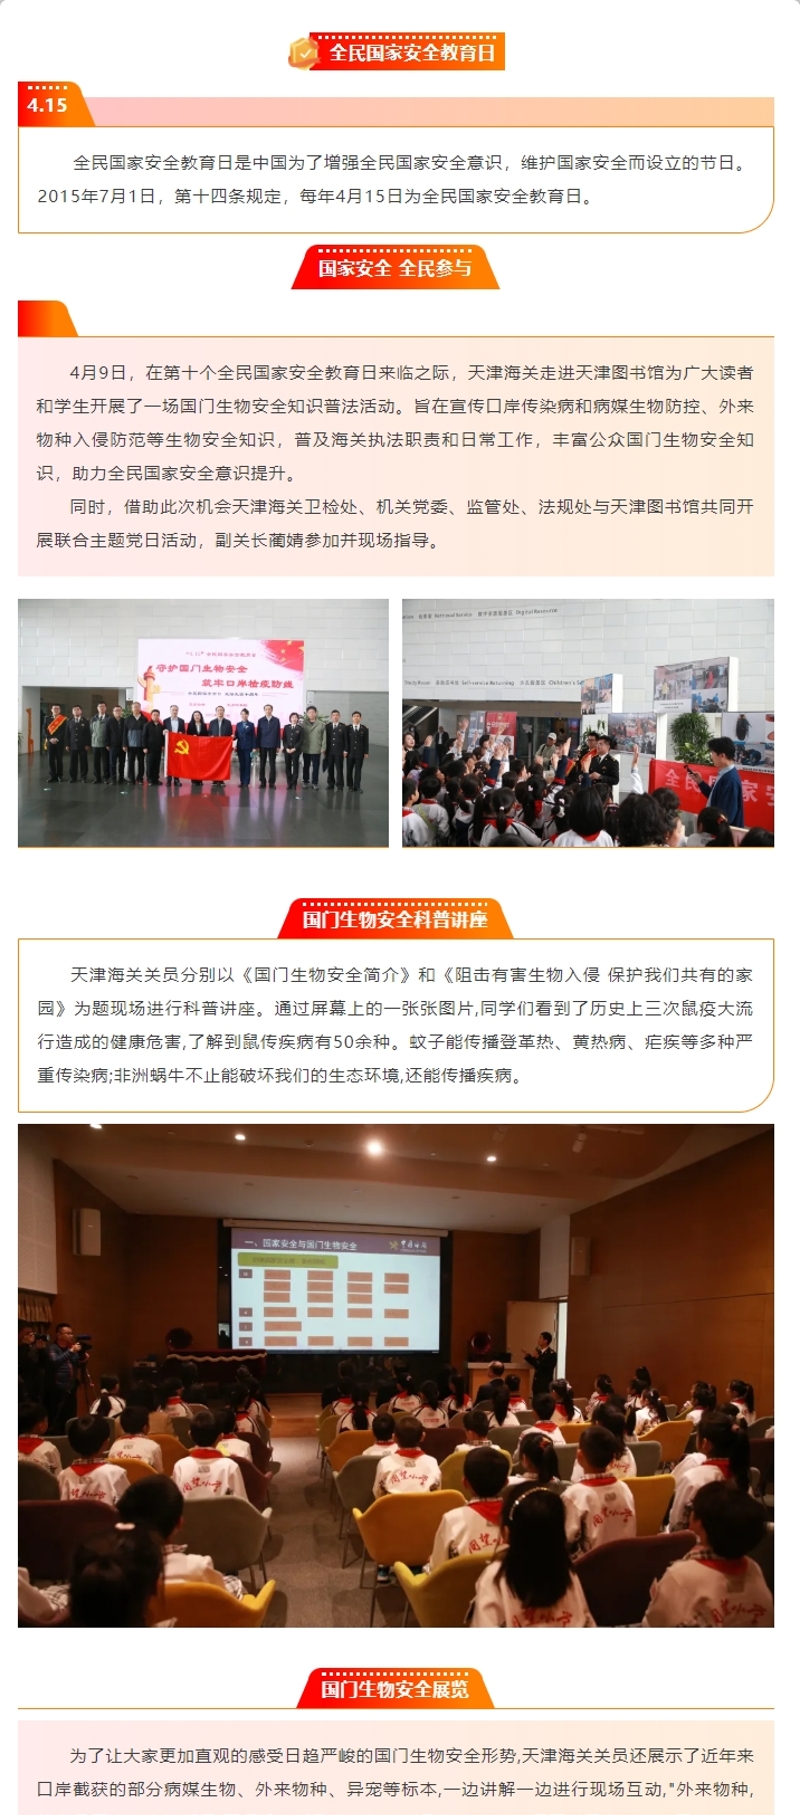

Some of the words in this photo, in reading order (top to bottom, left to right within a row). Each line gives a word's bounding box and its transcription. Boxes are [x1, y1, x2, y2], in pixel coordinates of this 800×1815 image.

[330, 43, 495, 63] 全民国家安全教育日
[27, 97, 67, 113] 4.15
[73, 154, 742, 172] 全民国家安全教育日是中国为了增强全民国家安全意识，维护国家安全而设立的节日。
[37, 188, 590, 206] 2015年7月1日，第十四条规定，每年4月15日为全民国家安全教育日。
[319, 258, 393, 279] 国家安全
[399, 258, 472, 279] 全民参与
[69, 364, 754, 382] 4月9日，在第十个全民国家安全教育日来临之际，天津海关走进天津图书馆为广大读者
[36, 397, 755, 416] 和学生开展了一场国门生物安全知识普法活动。旨在宣传口岸传染病和病媒生物防控、外来
[36, 431, 755, 449] 物种入侵防范等生物安全知识，普及海关执法职责和日常工作，丰富公众国门生物安全知
[36, 465, 293, 483] 识，助力全民国家安全意识提升。
[69, 498, 754, 516] 同时，借助此次机会天津海关卫检处、机关党委、监管处、法规处与天津图书馆共同开
[156, 664, 248, 674] 守护国门生物安全
[201, 679, 294, 689] 筑牢口岸检疫防线
[303, 910, 488, 930] 国门生物安全科普讲座
[70, 966, 601, 984] 天津海关关员分别以《国门生物安全简介》和《阻击有害生物入侵
[607, 966, 753, 984] 保护我们共有的家
[321, 1680, 470, 1700] 国门生物安全展览
